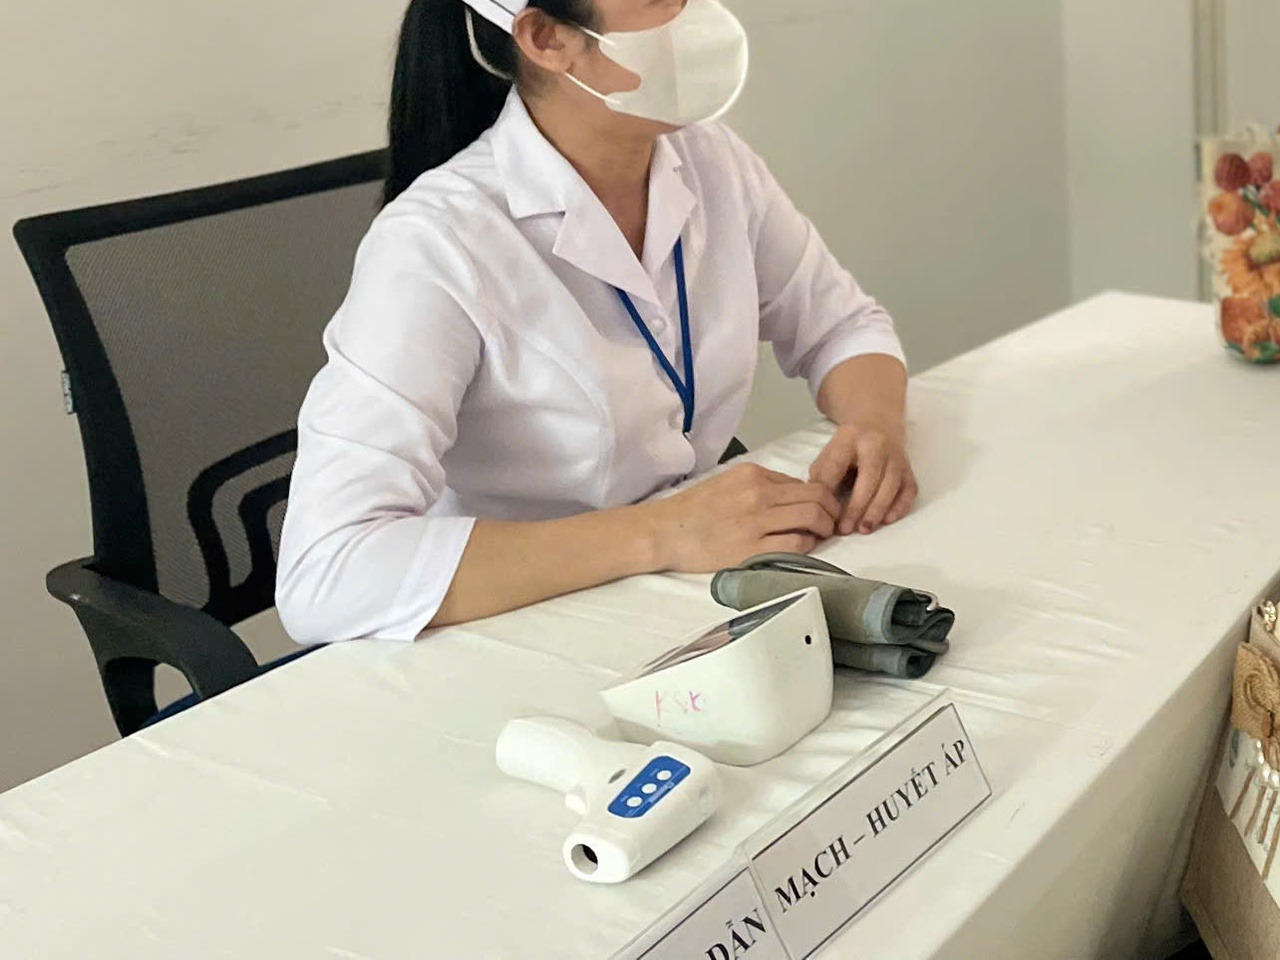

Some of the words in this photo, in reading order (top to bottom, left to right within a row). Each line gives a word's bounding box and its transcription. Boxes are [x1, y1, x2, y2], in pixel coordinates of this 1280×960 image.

[773, 834, 852, 914] MẠCH
[865, 761, 939, 838] HUYẾT
[940, 738, 967, 777] ÁP
[704, 907, 767, 960] DẪN
